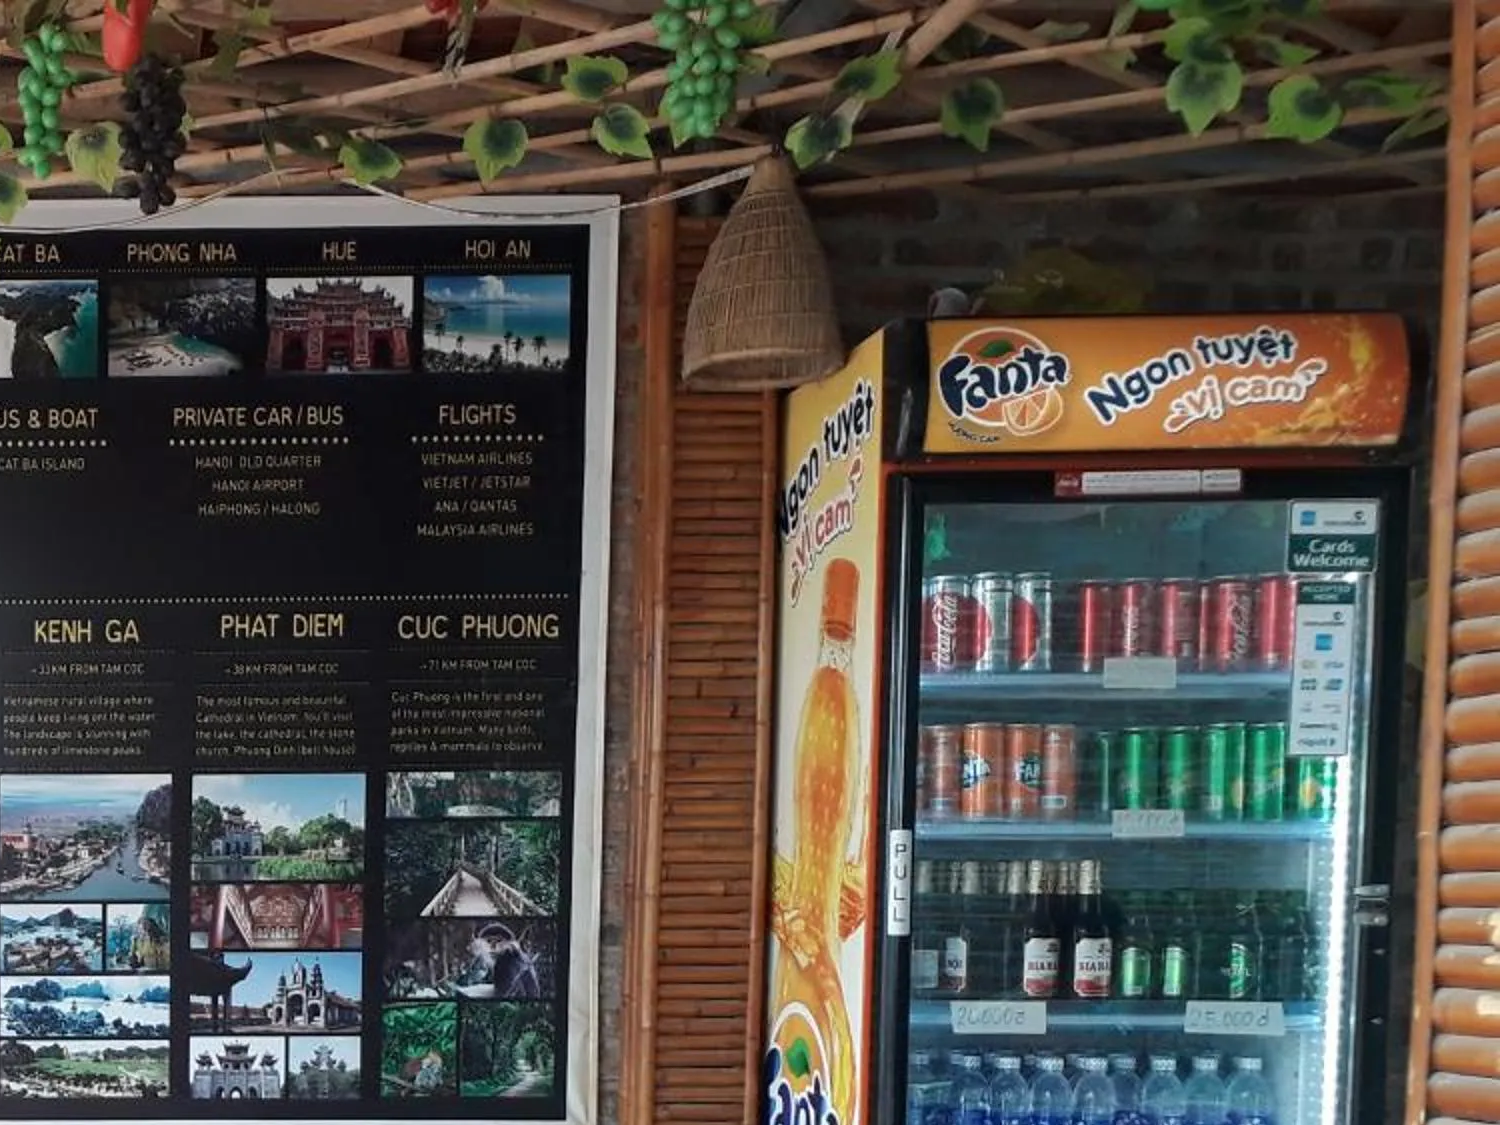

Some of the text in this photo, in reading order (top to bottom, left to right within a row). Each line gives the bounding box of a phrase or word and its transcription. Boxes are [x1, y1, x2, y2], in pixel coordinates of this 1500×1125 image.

[35, 243, 61, 263] BA
[128, 243, 236, 262] PHONG NHA
[323, 241, 356, 260] HUE
[466, 240, 530, 258] HOI AN
[939, 343, 1069, 418] Fanta
[1088, 328, 1295, 423] Ngon tuyệt
[1227, 376, 1302, 405] cam
[28, 410, 40, 428] &
[49, 408, 98, 428] BOAT
[174, 407, 246, 426] PRIVATE
[254, 407, 292, 426] CAR
[307, 406, 343, 425] BUS
[440, 404, 516, 424] FLIGHTS
[421, 453, 475, 465] VIETNAM
[815, 499, 852, 547] cam
[1308, 539, 1357, 553] Cards
[1293, 553, 1370, 567] Welcome
[35, 620, 138, 643] KENH GA
[221, 614, 343, 638] PHAT DIEM
[399, 614, 558, 639] CUC PHUONG
[893, 843, 907, 924] PULL
